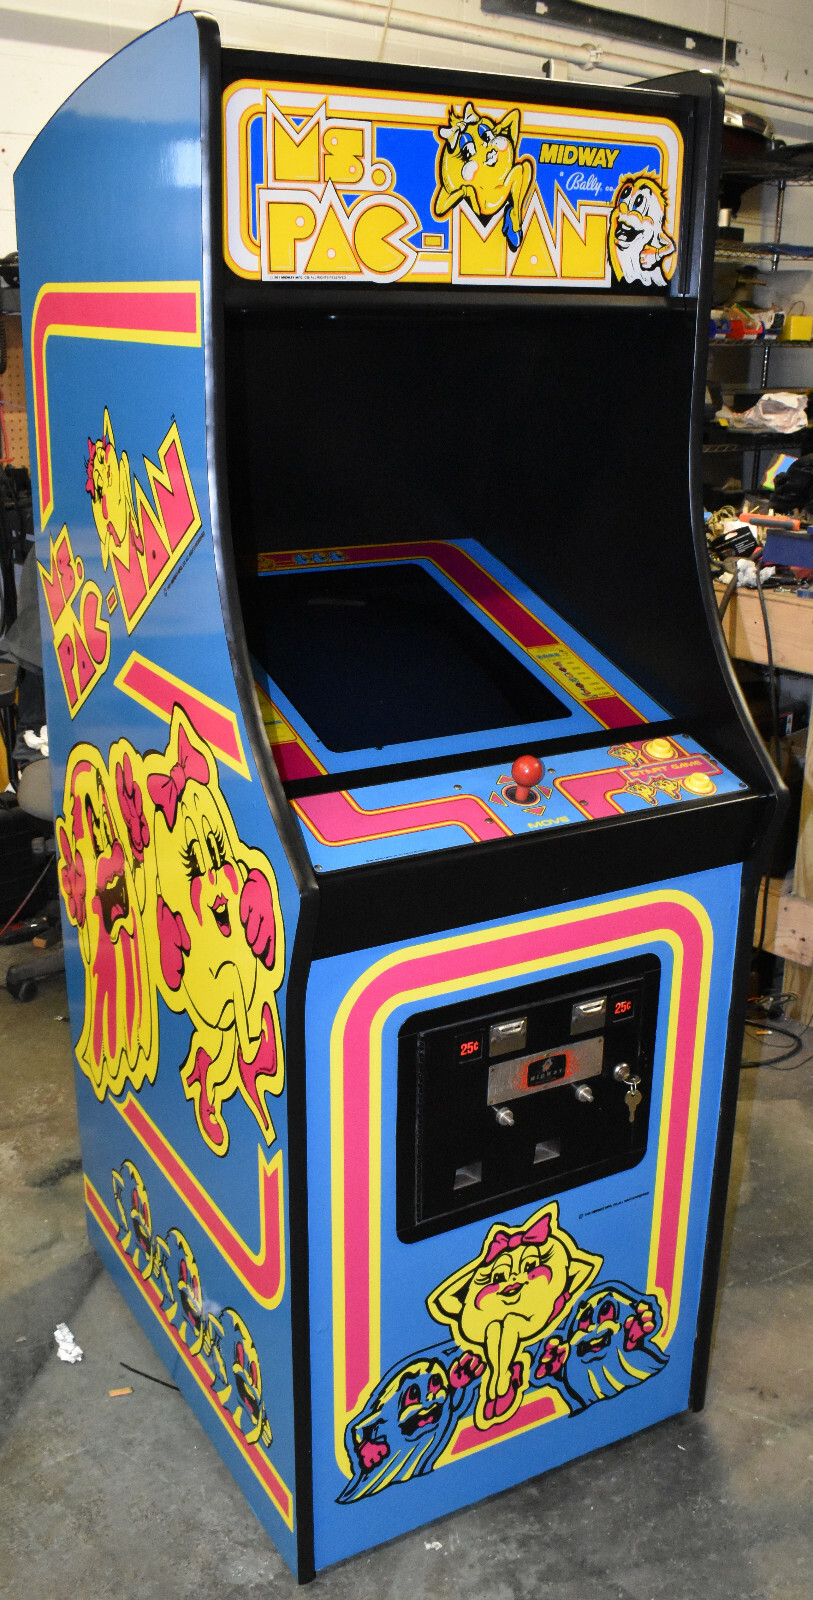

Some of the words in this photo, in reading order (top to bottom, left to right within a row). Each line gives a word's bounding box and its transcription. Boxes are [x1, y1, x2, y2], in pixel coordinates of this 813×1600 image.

[267, 98, 389, 191] MS.
[539, 142, 621, 169] MIDWAY
[566, 172, 602, 197] Bally
[260, 180, 612, 286] PAC-MAN
[37, 523, 85, 626] MS.
[629, 765, 668, 777] START
[671, 760, 703, 769] GAME
[527, 815, 570, 829] MOVE
[613, 1000, 632, 1015] 25¢
[460, 1041, 479, 1056] 25¢
